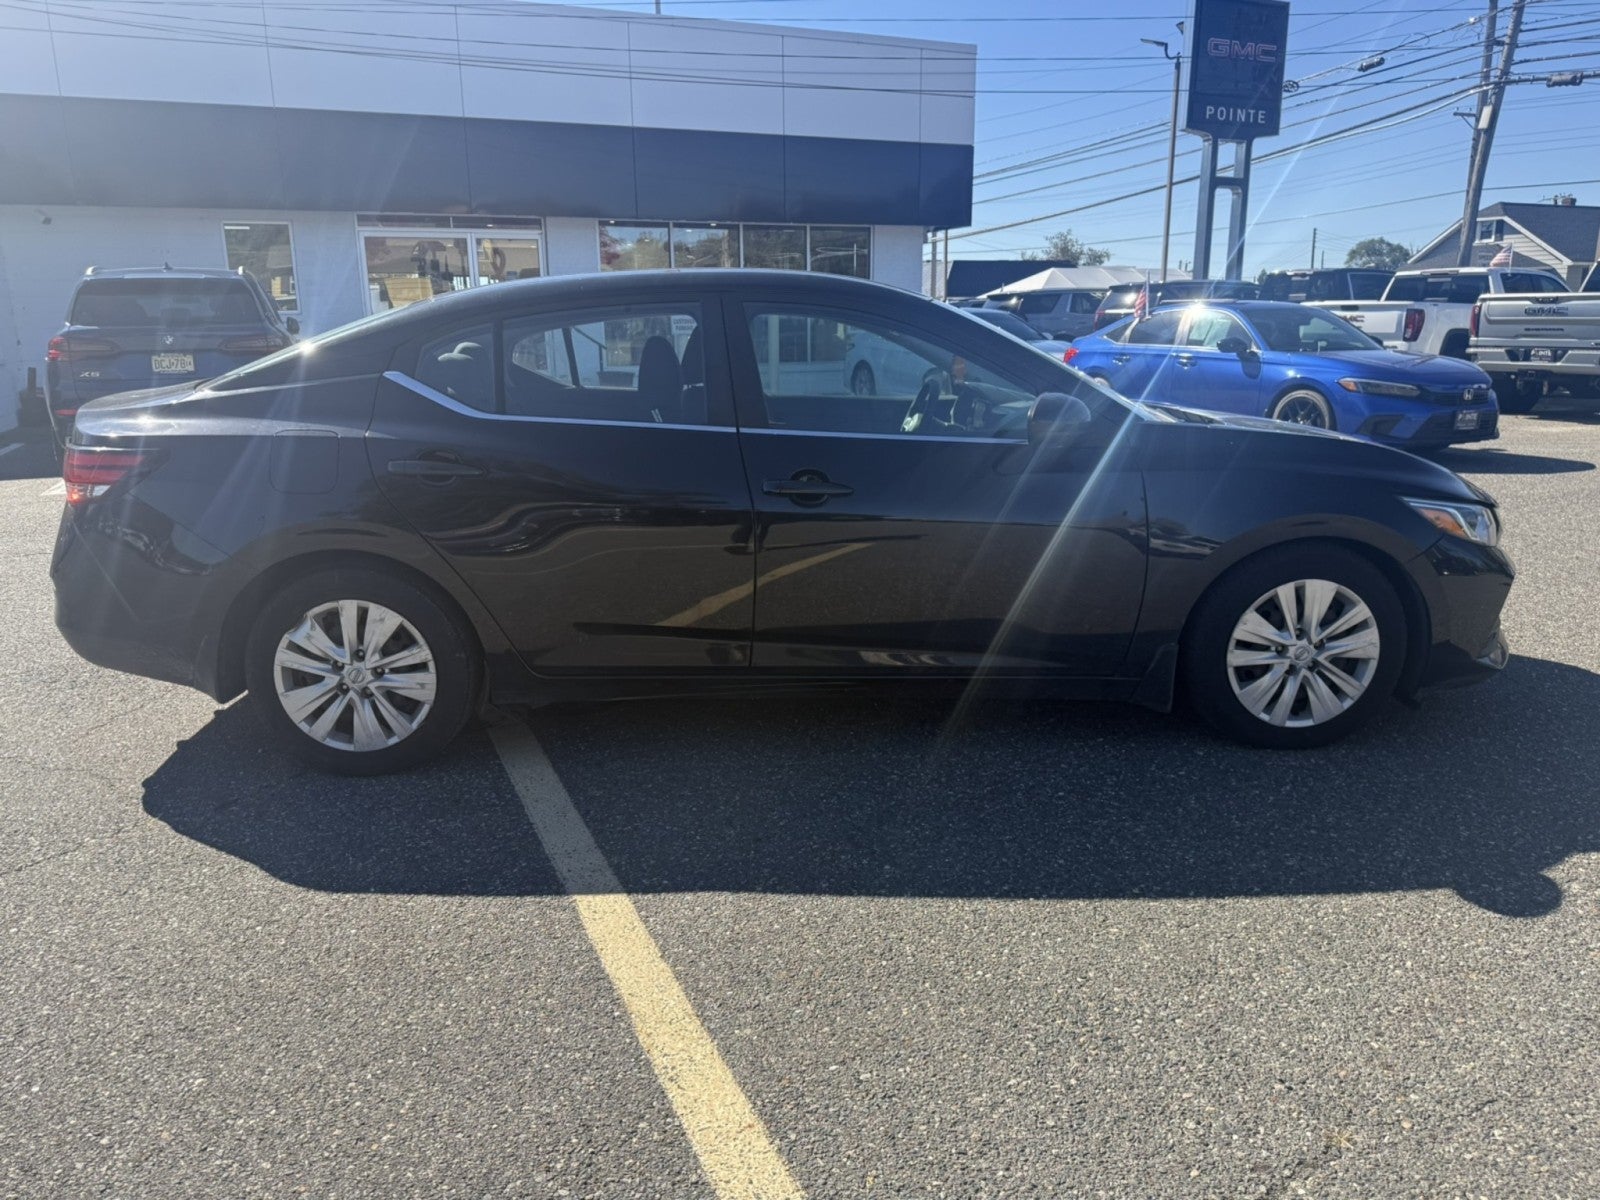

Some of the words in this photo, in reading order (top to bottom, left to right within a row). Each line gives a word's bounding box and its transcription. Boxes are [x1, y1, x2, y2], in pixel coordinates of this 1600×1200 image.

[1207, 37, 1278, 62] GMC
[1205, 105, 1267, 124] POINTE
[1524, 306, 1569, 317] GMC
